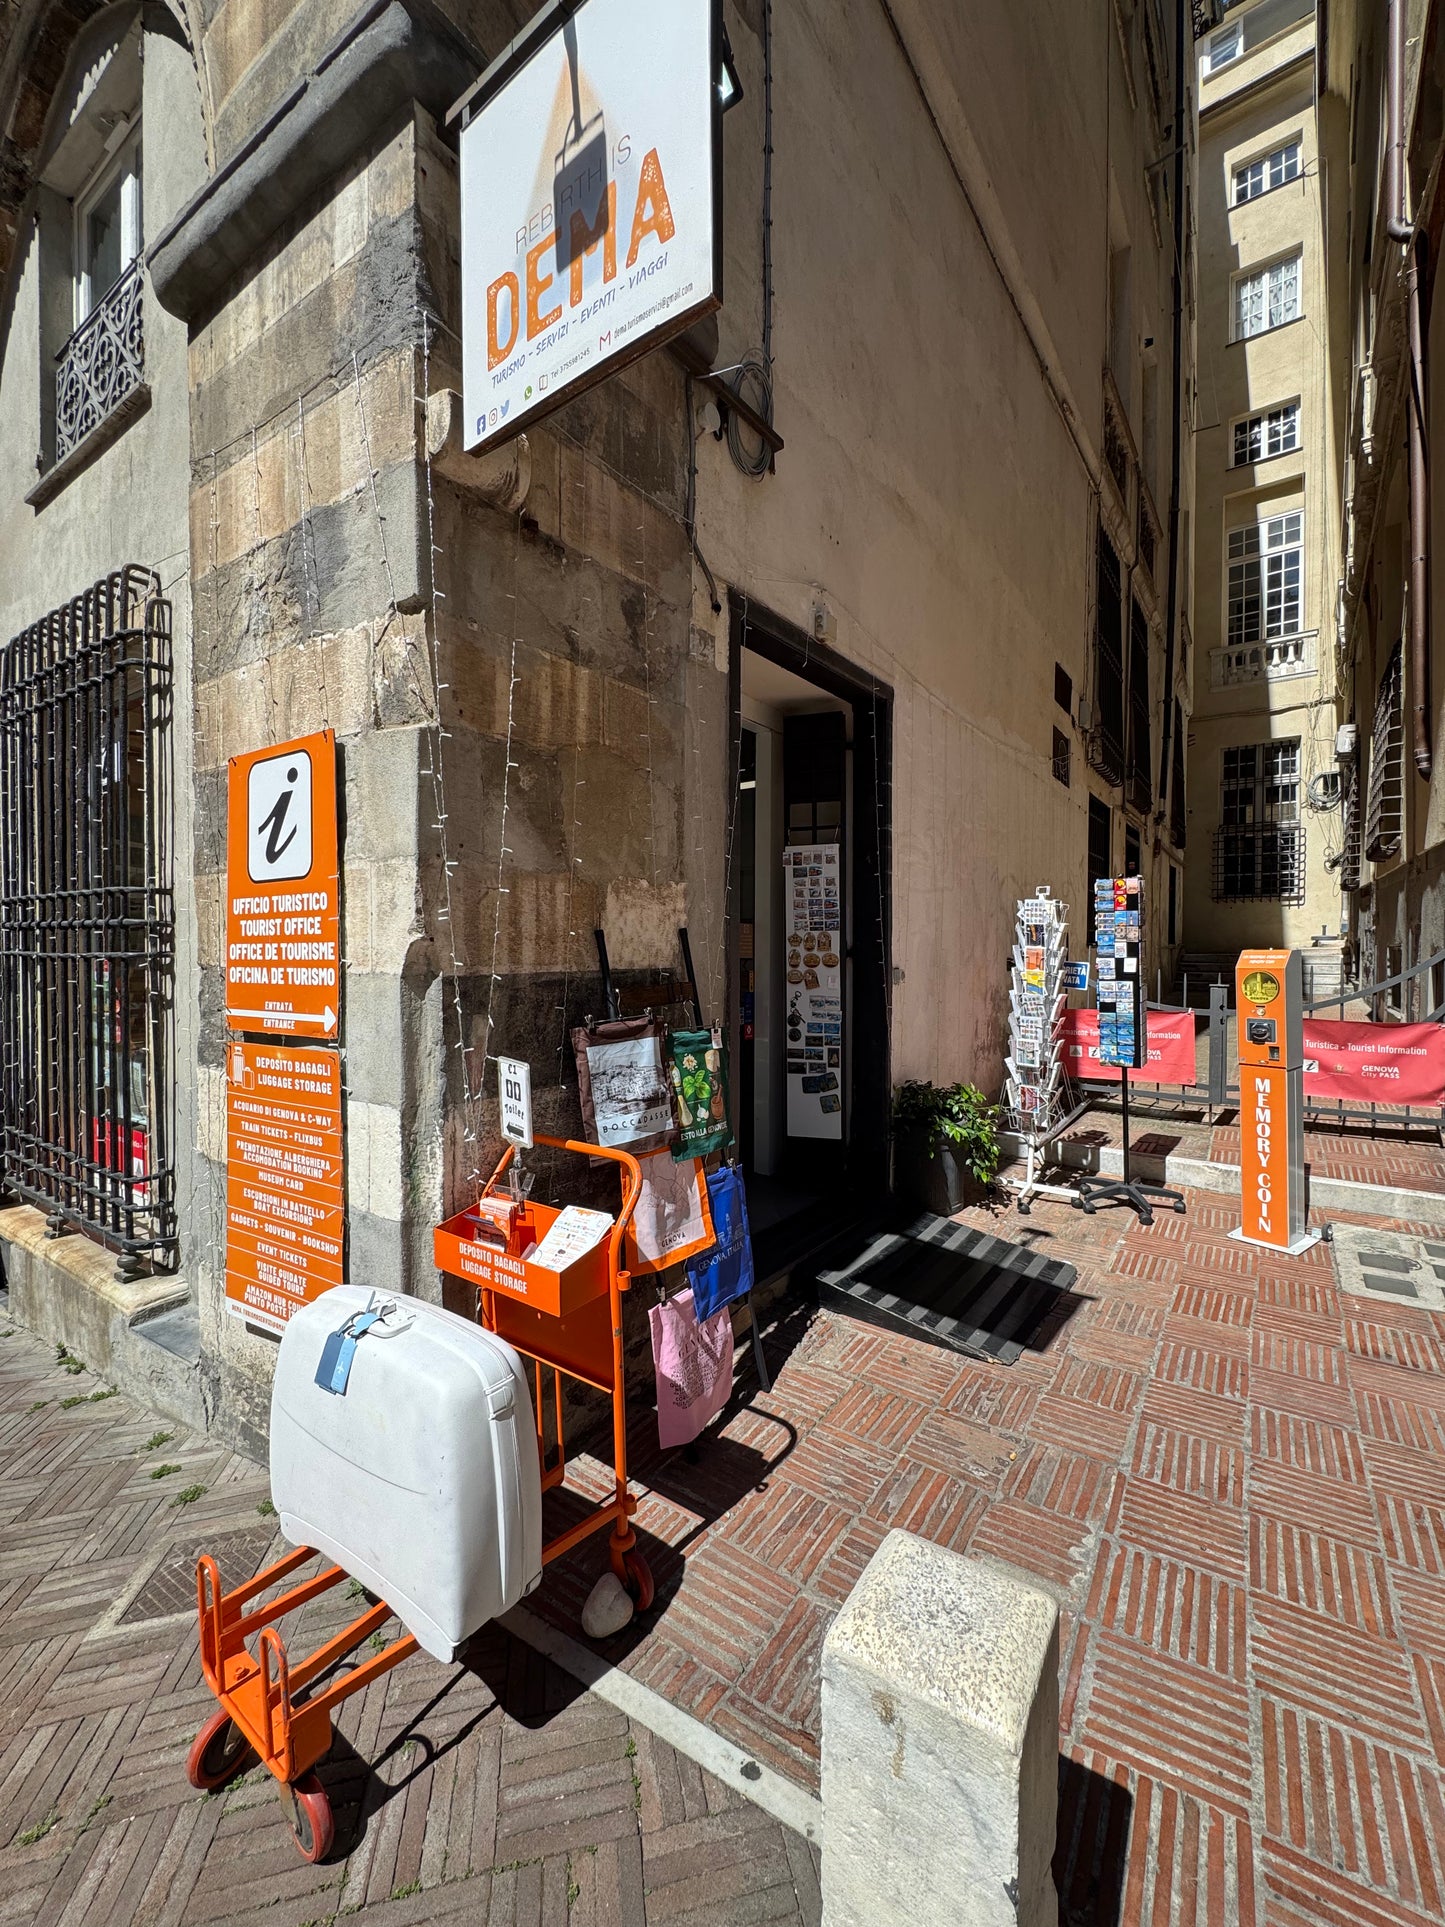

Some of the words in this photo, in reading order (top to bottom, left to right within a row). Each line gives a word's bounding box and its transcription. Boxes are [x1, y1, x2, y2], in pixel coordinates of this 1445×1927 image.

[612, 134, 631, 172] IS
[487, 147, 675, 372] DEMA
[492, 355, 525, 388] TURISMO
[536, 322, 569, 356] SERVIZI
[580, 288, 616, 323] EVENTI
[629, 252, 668, 289] VIAGGI
[233, 896, 270, 915] UFFICIO
[271, 892, 328, 913] TURISTICO
[240, 918, 282, 936] TOURIST
[284, 916, 321, 935] OFFICE
[229, 943, 263, 960] OFFICE
[265, 943, 278, 960] DE
[280, 942, 335, 960] TOURISME
[229, 967, 269, 984] OFICINA
[271, 967, 284, 985] DE
[286, 967, 335, 986] TURISMO
[264, 1001, 293, 1012] ENTRATA
[263, 1019, 295, 1029] ENTRANCE
[1305, 1040, 1339, 1050] Turistica
[1347, 1043, 1375, 1053] Tourist
[1378, 1044, 1427, 1056] Information
[256, 1056, 293, 1072] DEPOSITO
[295, 1061, 331, 1076] BAGAGLI
[1362, 1065, 1399, 1073] GENOVA
[257, 1073, 293, 1089] LUGGAGE
[295, 1079, 332, 1095] STORAGE
[233, 1100, 263, 1114] ACQUARIO
[265, 1107, 271, 1115] DI
[273, 1108, 299, 1121] GENOVA
[300, 1114, 306, 1122] &
[307, 1115, 332, 1127] C-WAY
[603, 1110, 669, 1133] BOCCADASSE
[1255, 1077, 1271, 1168] MEMORY
[241, 1121, 260, 1133] TRAIN
[261, 1125, 288, 1140] TICKETS
[294, 1133, 322, 1146] FLIXBUS
[236, 1140, 283, 1159] PRENOTAZIONE
[284, 1152, 331, 1171] ALBERGHIERA
[243, 1152, 292, 1171] ACCOMODATION
[293, 1164, 323, 1179] BOOKING
[258, 1171, 284, 1186] MUSEUM
[286, 1178, 304, 1191] CARD
[243, 1188, 280, 1205] ESCURSIONI
[281, 1199, 288, 1209] IN
[290, 1201, 325, 1220] BATTELLO
[254, 1200, 271, 1212] BOAT
[272, 1206, 313, 1226] EXCURSIONS
[1257, 1173, 1272, 1233] COIN
[230, 1212, 259, 1229] GADGETS
[264, 1223, 297, 1242] SOUVENIR
[303, 1236, 339, 1256] BOOKSHOP
[661, 1231, 686, 1248] GENOVA
[257, 1242, 278, 1257] EVENT
[279, 1249, 307, 1268] TICKETS
[459, 1242, 492, 1264] DEPOSITO
[494, 1254, 525, 1277] BAGAGLI
[256, 1260, 277, 1277] VISITE
[278, 1269, 307, 1288] GUIDATE
[258, 1270, 281, 1288] GUIDED
[282, 1279, 305, 1297] TOURS
[461, 1258, 492, 1280] LUGGAGE
[494, 1271, 528, 1294] STORAGE
[244, 1292, 265, 1309] PUNTO
[267, 1302, 287, 1318] POSTE
[246, 1284, 272, 1302] AMAZON
[273, 1294, 287, 1308] HUB
